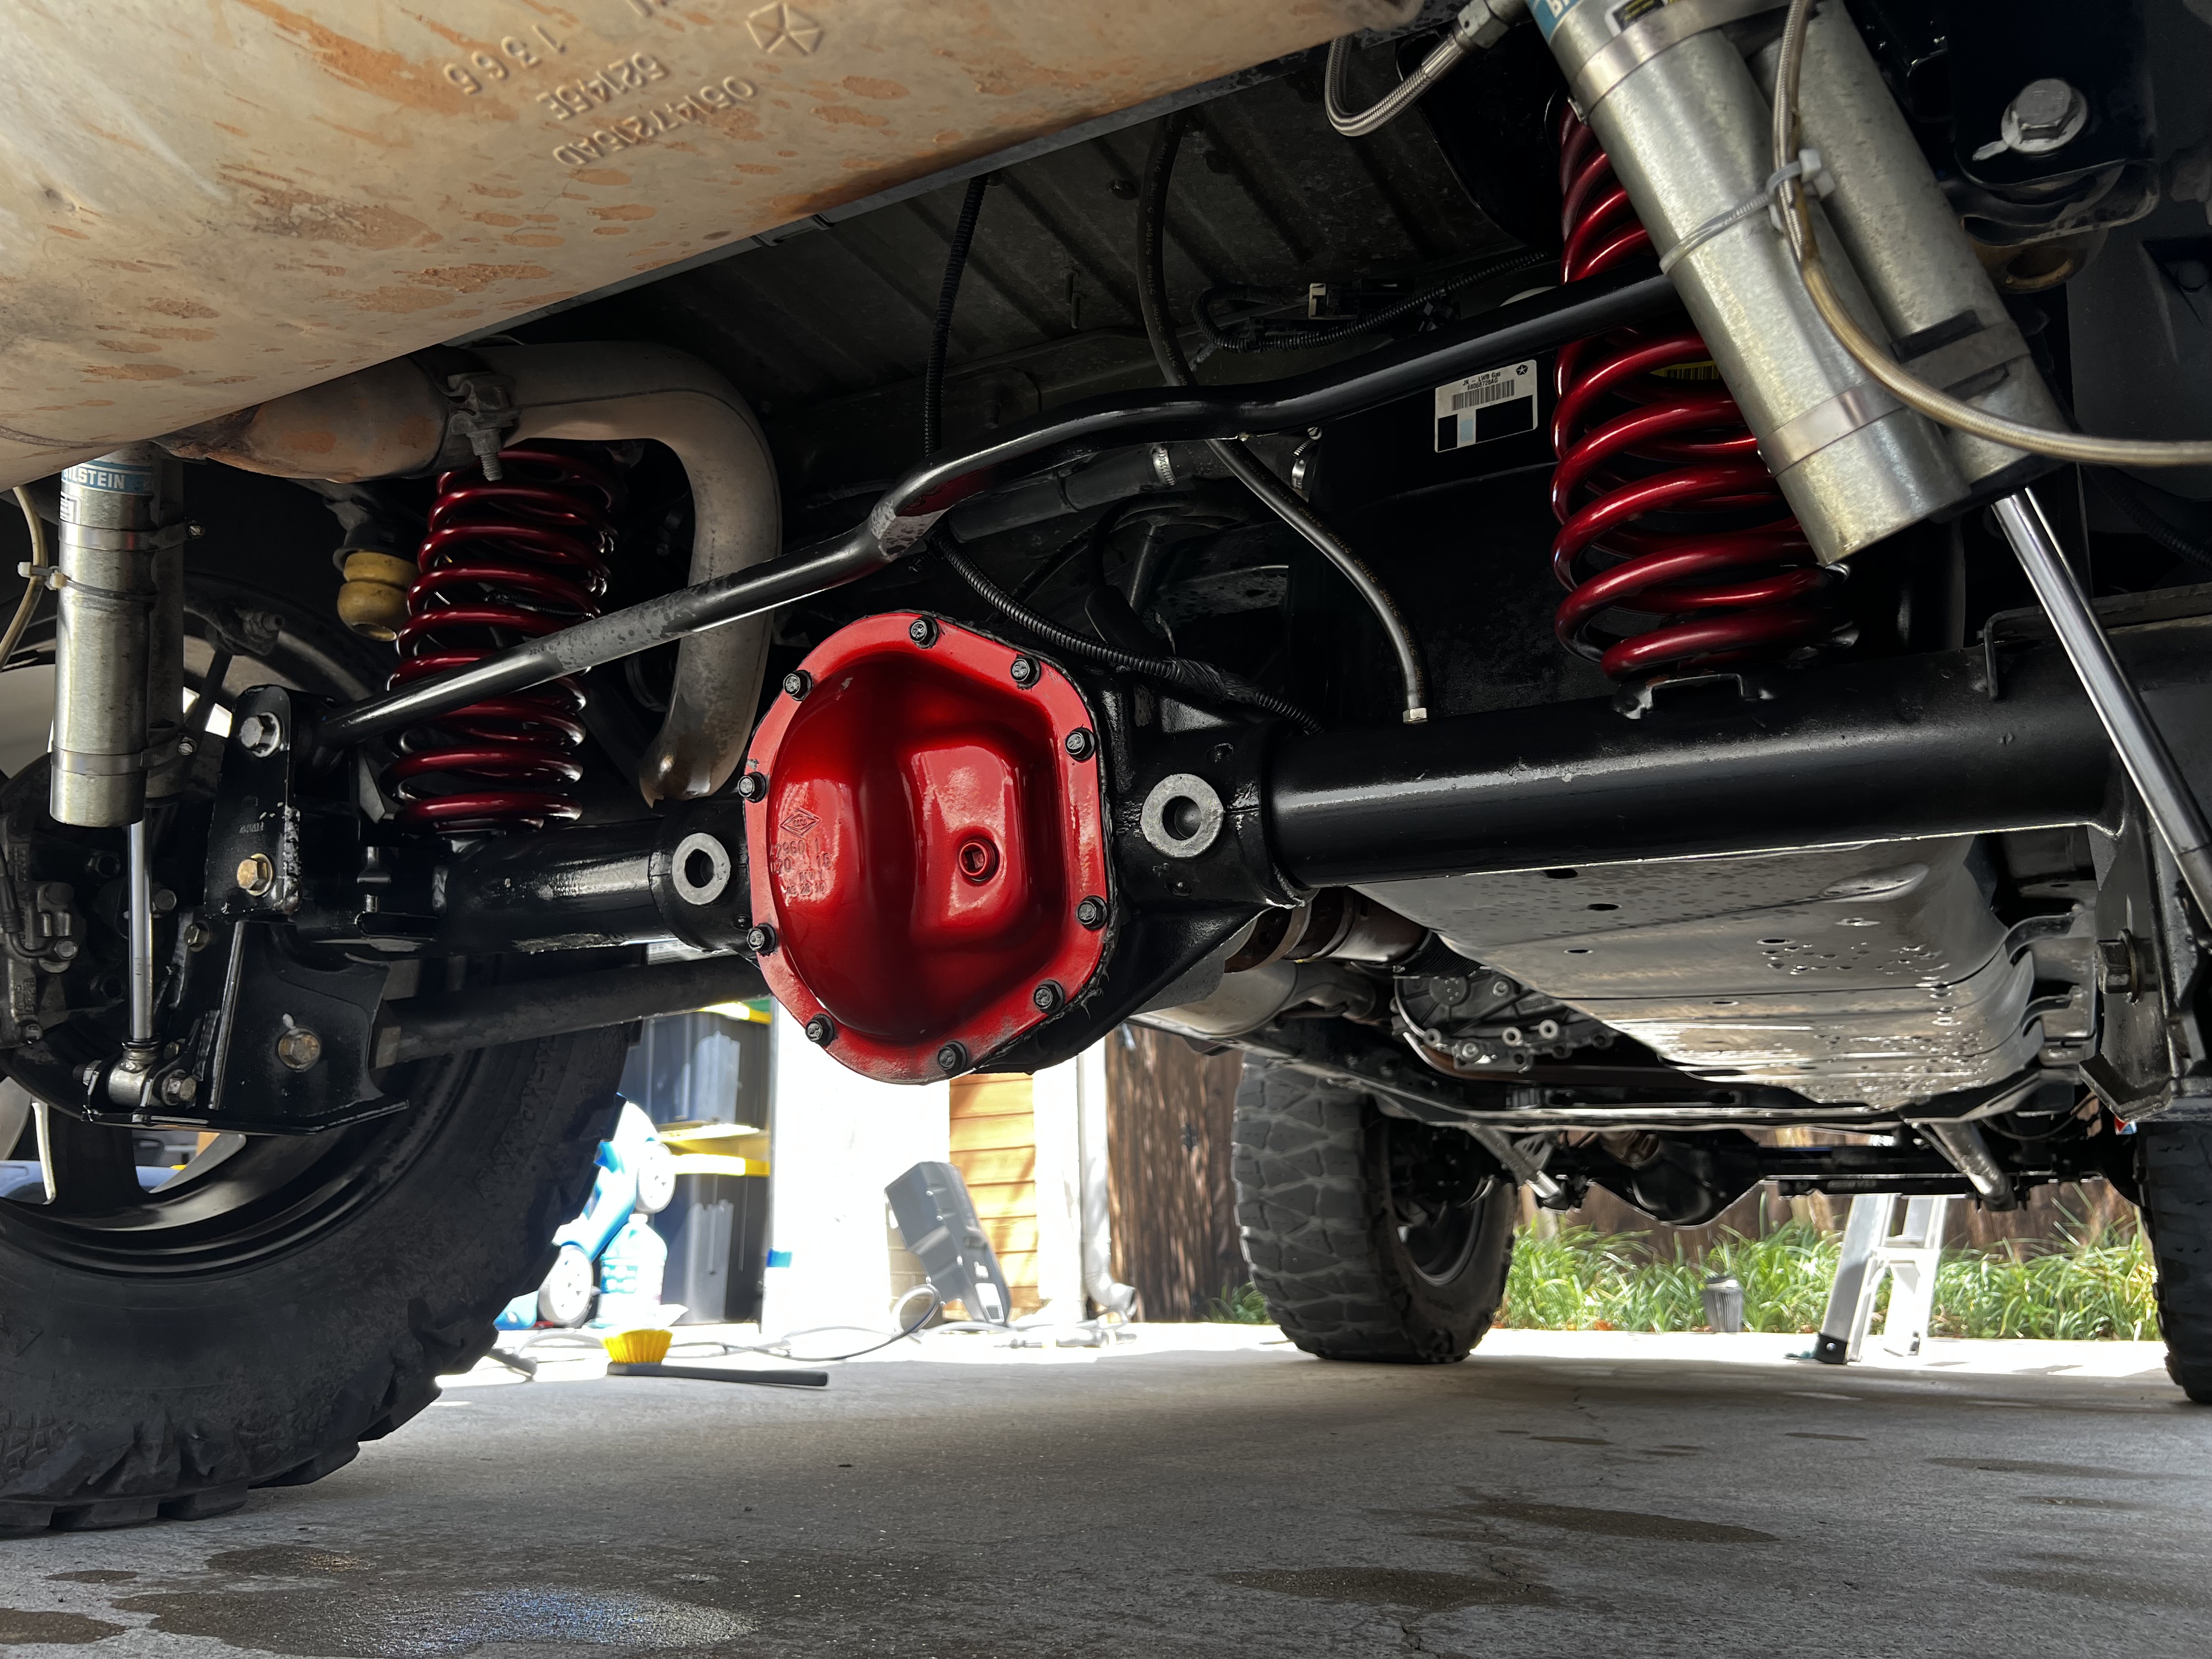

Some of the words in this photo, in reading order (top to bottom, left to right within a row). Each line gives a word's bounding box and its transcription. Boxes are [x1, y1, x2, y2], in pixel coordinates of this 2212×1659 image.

[536, 52, 671, 121] 52145E
[1478, 374, 1489, 382] LWB
[62, 465, 125, 489] BILSTEIN
